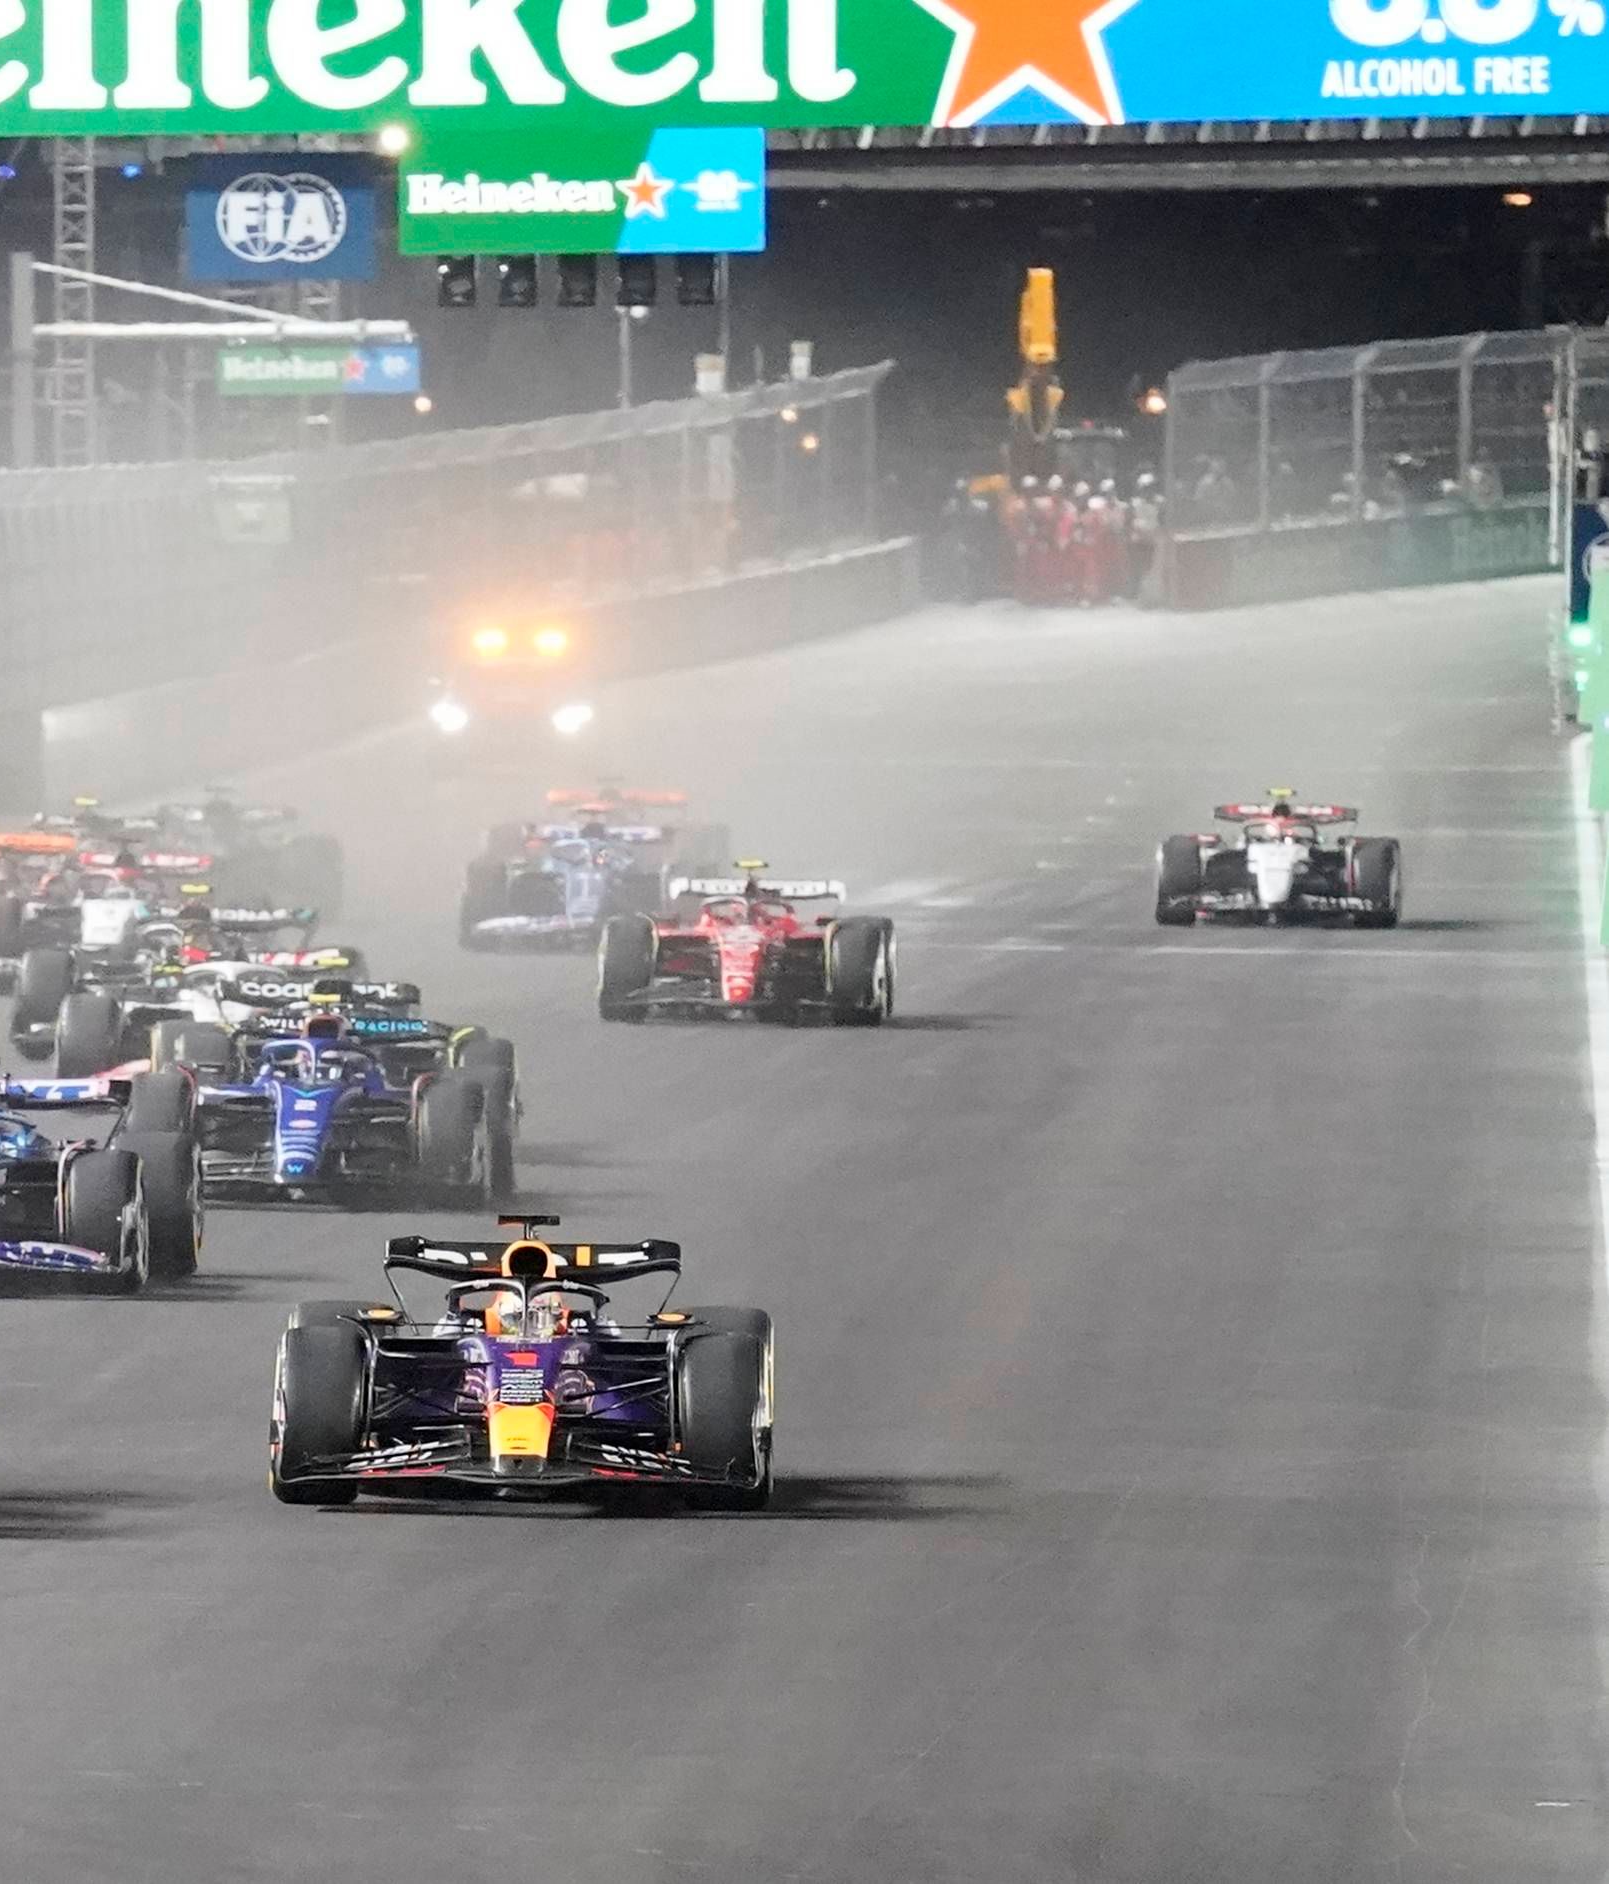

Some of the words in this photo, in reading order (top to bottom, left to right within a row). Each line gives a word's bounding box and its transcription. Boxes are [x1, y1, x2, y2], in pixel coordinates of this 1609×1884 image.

[1320, 58, 1465, 98] ALCOHOL
[1473, 56, 1551, 95] FREE
[406, 173, 616, 214] Heineken
[353, 1022, 422, 1033] RACING
